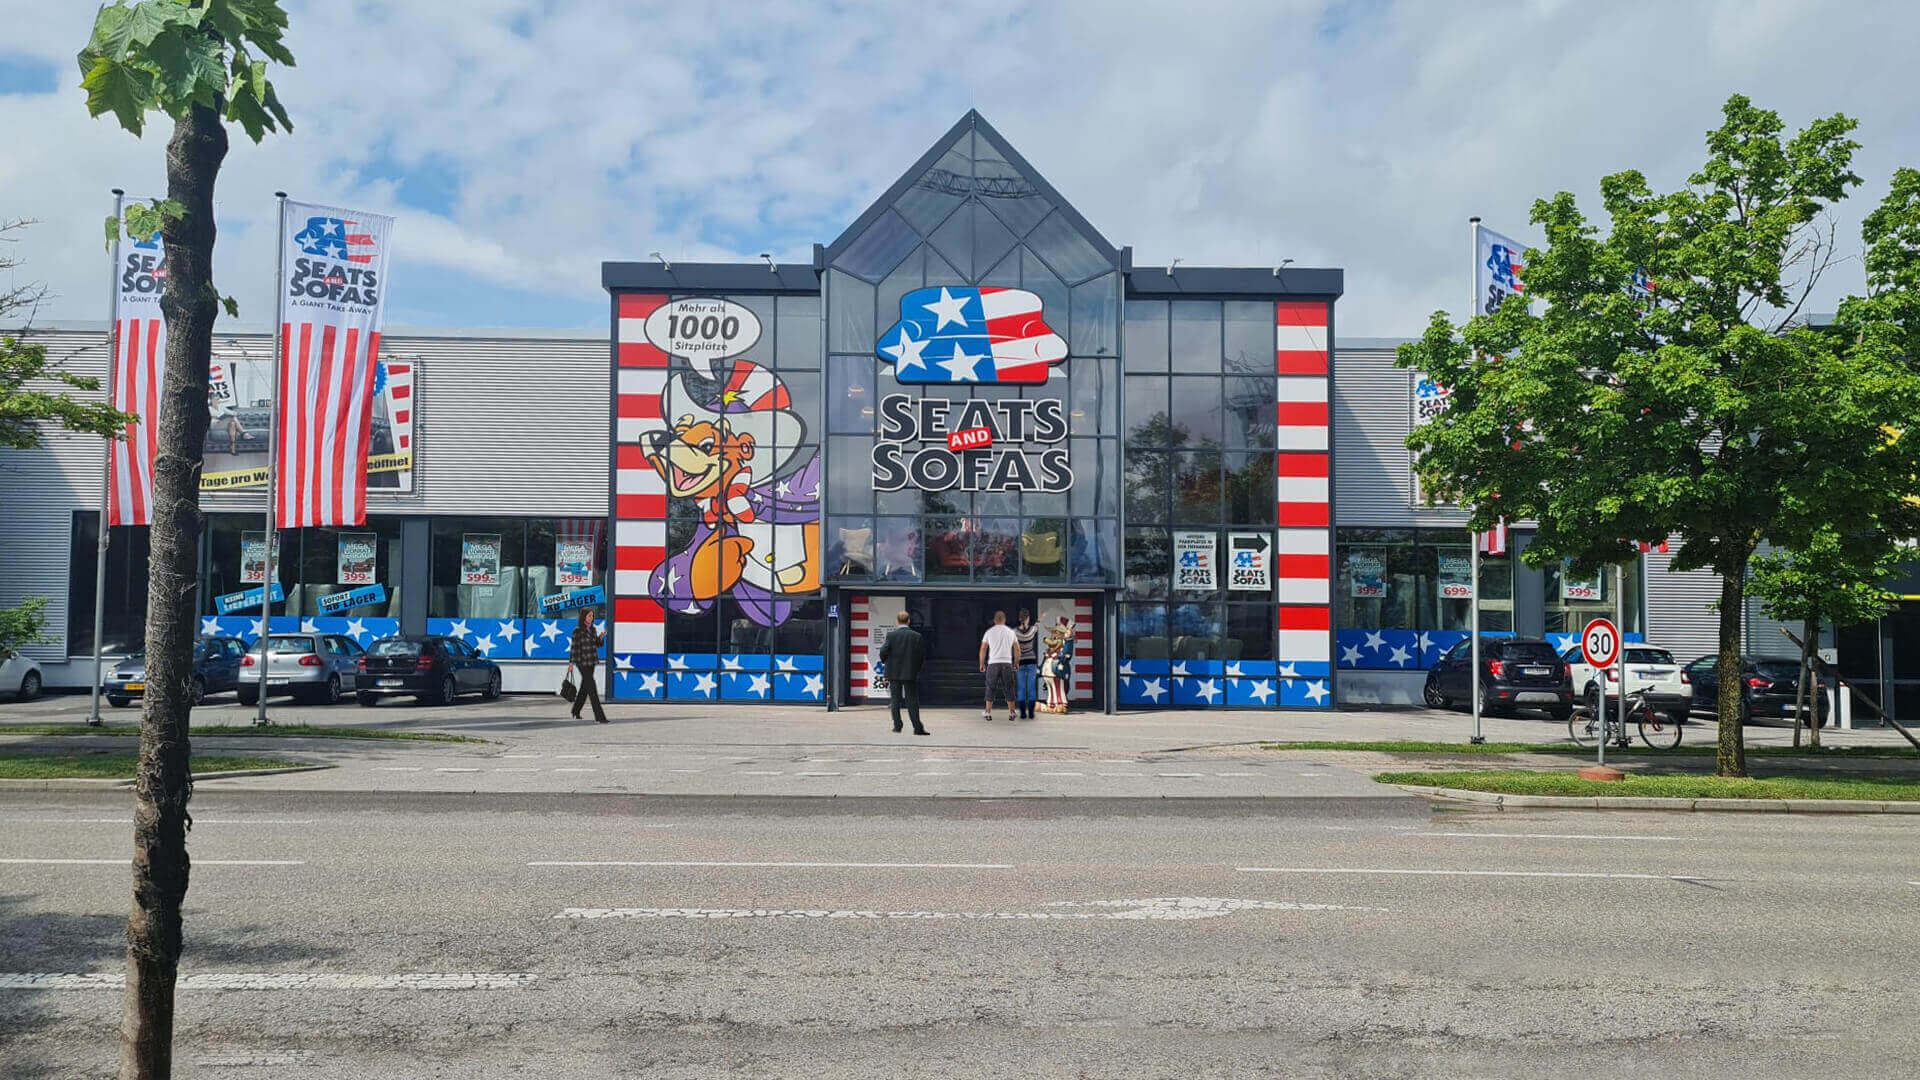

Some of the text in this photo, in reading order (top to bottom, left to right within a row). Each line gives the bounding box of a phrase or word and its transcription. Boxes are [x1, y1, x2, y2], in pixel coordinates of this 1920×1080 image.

[295, 257, 377, 287] SEATS
[290, 277, 378, 306] SOFAS
[300, 299, 324, 309] GIANT
[679, 304, 725, 313] Mehr als
[668, 315, 739, 340] 1000
[881, 393, 1068, 444] SEATS
[950, 429, 990, 448] AND
[367, 457, 409, 470] eöffnet
[872, 442, 1074, 492] SOFAS
[201, 478, 228, 488] Tage
[231, 475, 250, 485] pro
[1181, 569, 1210, 577] SEATS
[1233, 577, 1266, 585] SOFAS
[344, 592, 376, 608] LAGER
[564, 594, 597, 609] LAGER
[1590, 633, 1611, 655] 30
